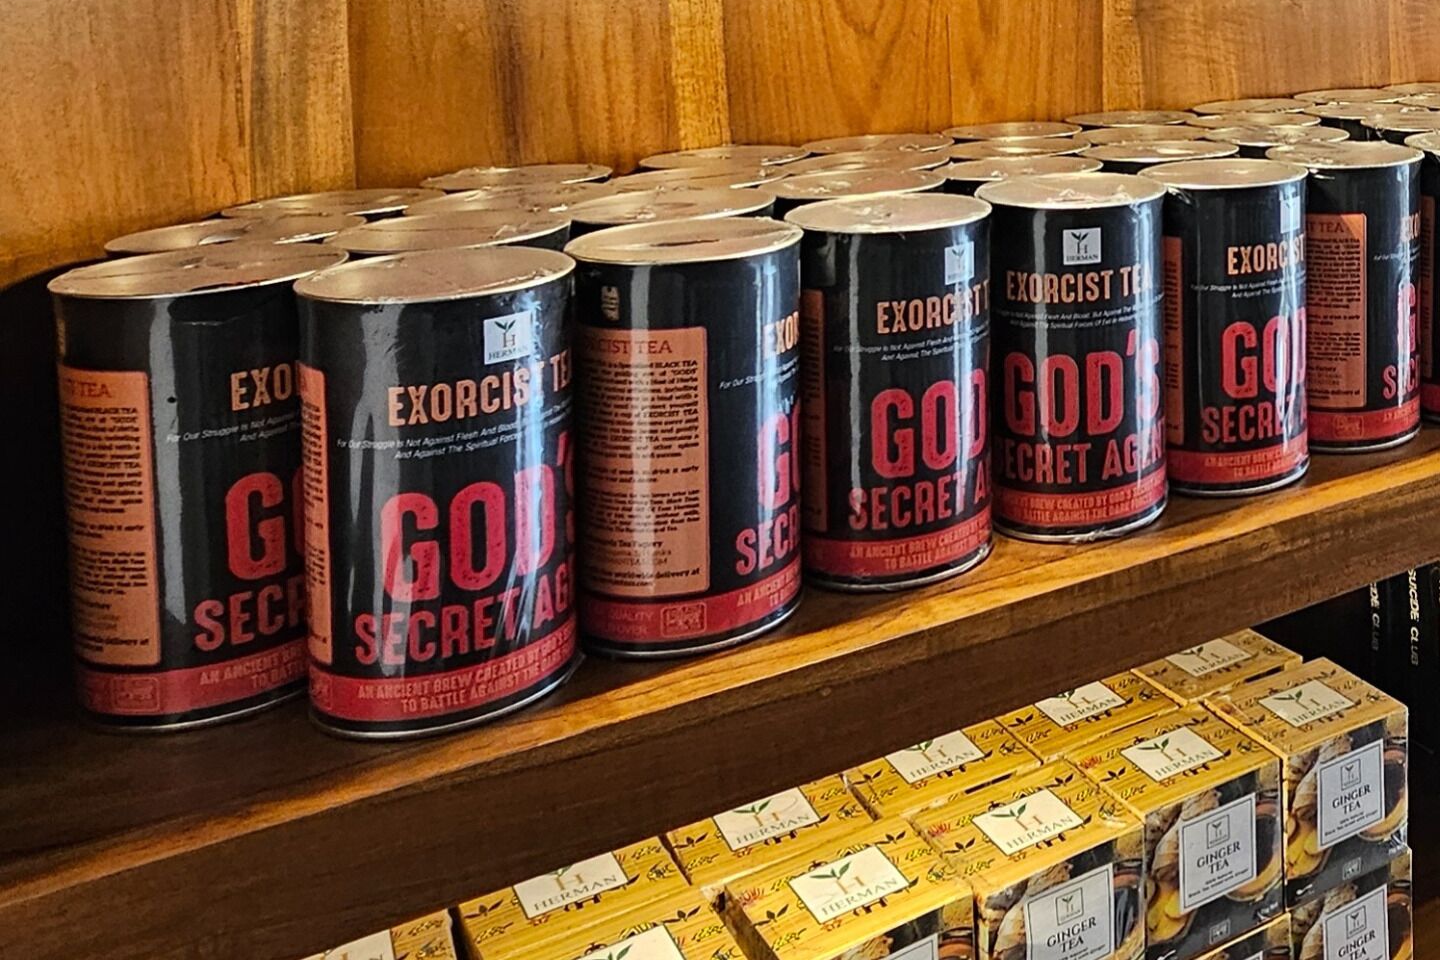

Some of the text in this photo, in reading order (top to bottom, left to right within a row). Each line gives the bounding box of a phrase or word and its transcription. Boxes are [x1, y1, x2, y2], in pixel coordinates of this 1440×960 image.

[1066, 253, 1098, 262] HERMAN
[1006, 269, 1114, 304] EXORCIST
[388, 361, 547, 427] EXORCIST
[1004, 330, 1159, 437] GOD'S
[871, 367, 986, 479] GOD
[394, 439, 497, 459] And Against The Spiritual
[407, 426, 497, 448] Not Flesh And
[849, 471, 965, 530] SECRET
[1057, 496, 1094, 509] CREATED
[908, 539, 933, 555] BREW
[885, 552, 932, 570] TO BATTLE
[355, 587, 521, 666] SECRET
[200, 655, 279, 685] AN ANCIENT
[358, 650, 539, 699] AN ANCIENT BREW CREATED BY
[1192, 651, 1246, 675] HERMAN
[252, 674, 270, 688] TO
[401, 666, 541, 713] TO BATTLE AGAINST THE
[1060, 696, 1118, 722] HERMAN
[1293, 699, 1346, 724] HERMAN
[909, 749, 976, 778] HERMAN
[1154, 749, 1216, 776] HERMAN
[1332, 784, 1371, 809] GINGER
[1343, 801, 1361, 815] TEA
[735, 812, 811, 845] HERMAN
[1006, 816, 1073, 849] HERMAN
[1196, 841, 1241, 868] GINGER
[1208, 859, 1229, 874] TEA
[533, 874, 617, 911] HERMAN
[822, 877, 897, 915] HERMAN
[1047, 916, 1097, 948] GINGER
[1060, 936, 1084, 953] TEA
[1338, 929, 1376, 958] GINGER
[1349, 947, 1366, 960] TEA
